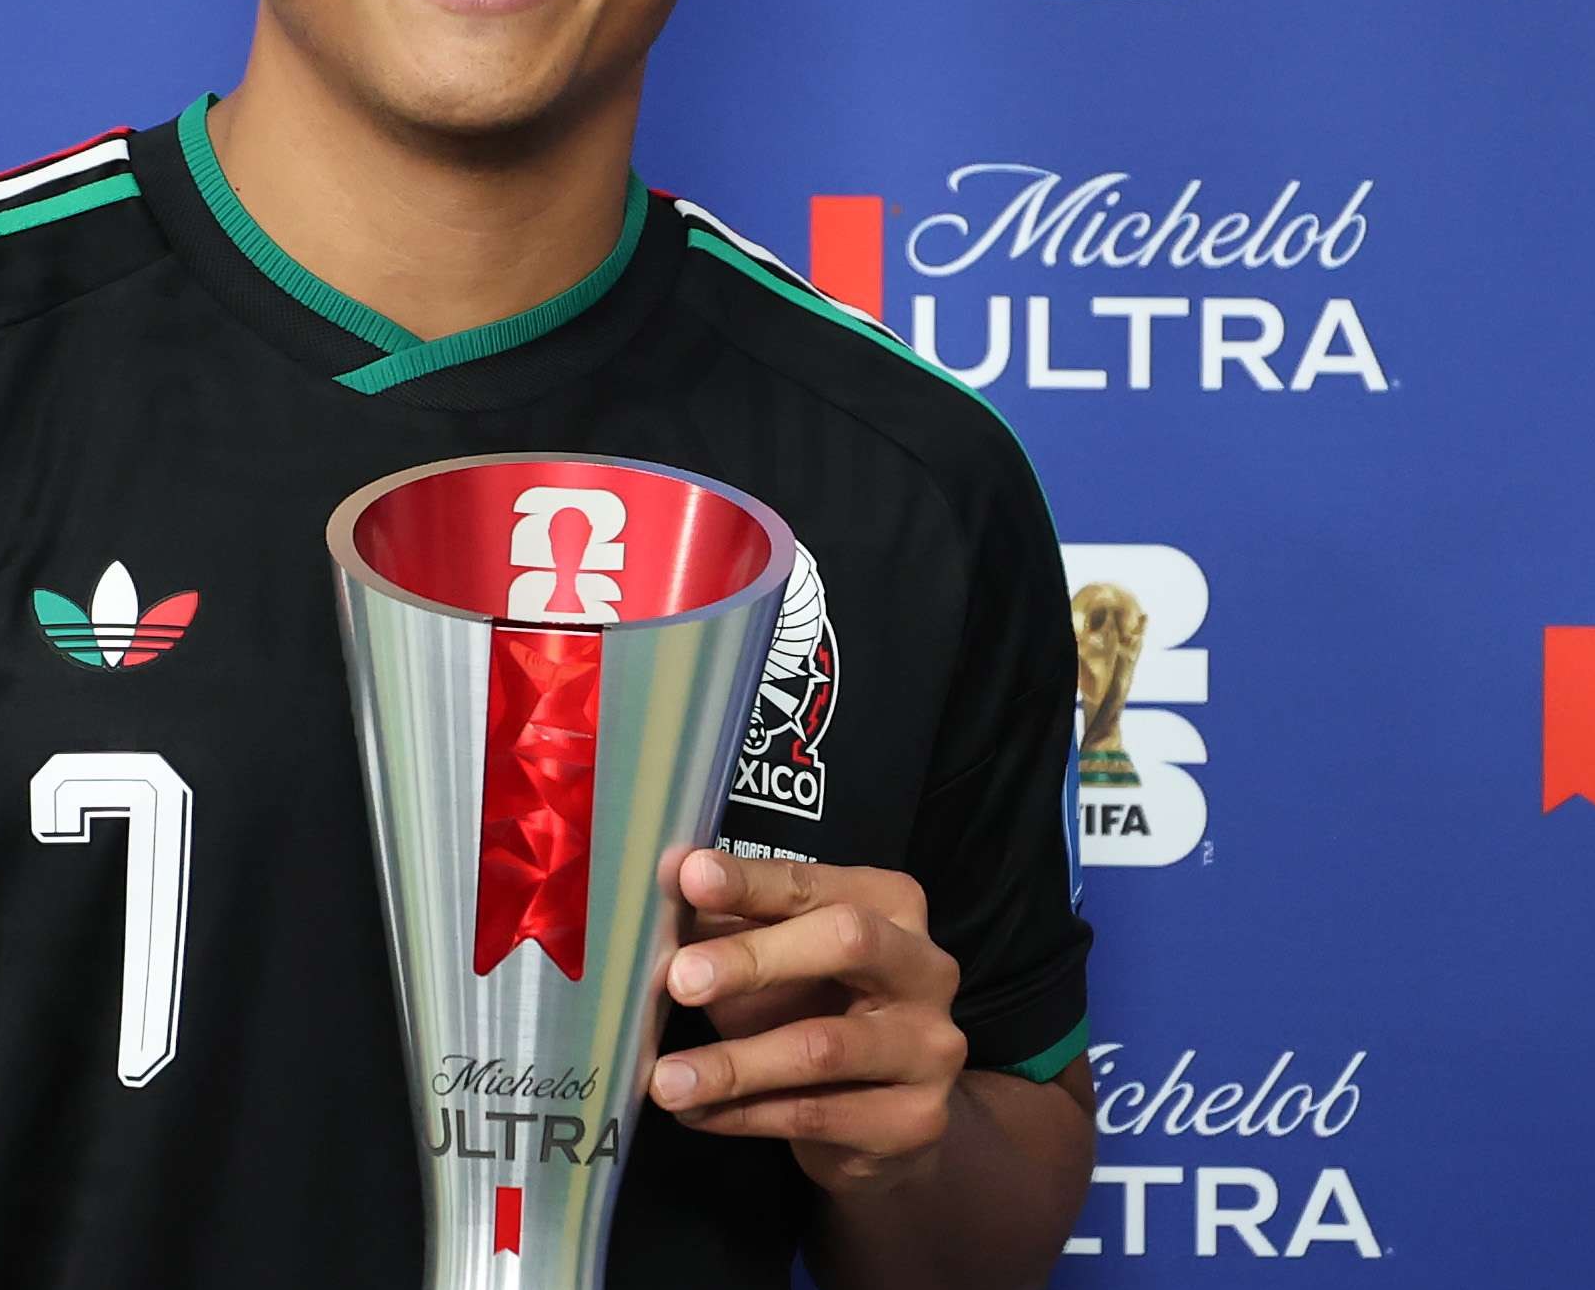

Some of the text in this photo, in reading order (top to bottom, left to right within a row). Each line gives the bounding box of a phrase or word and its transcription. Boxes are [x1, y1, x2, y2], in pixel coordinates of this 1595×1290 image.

[906, 164, 1373, 276] Michelob
[913, 295, 1388, 392] ULTRA
[735, 757, 818, 806] XICO
[1079, 804, 1151, 836] IFA
[30, 751, 193, 1089] 7
[432, 1054, 599, 1101] Michelob
[1088, 1043, 1367, 1138] chelob
[1063, 1166, 1382, 1258] TRA
